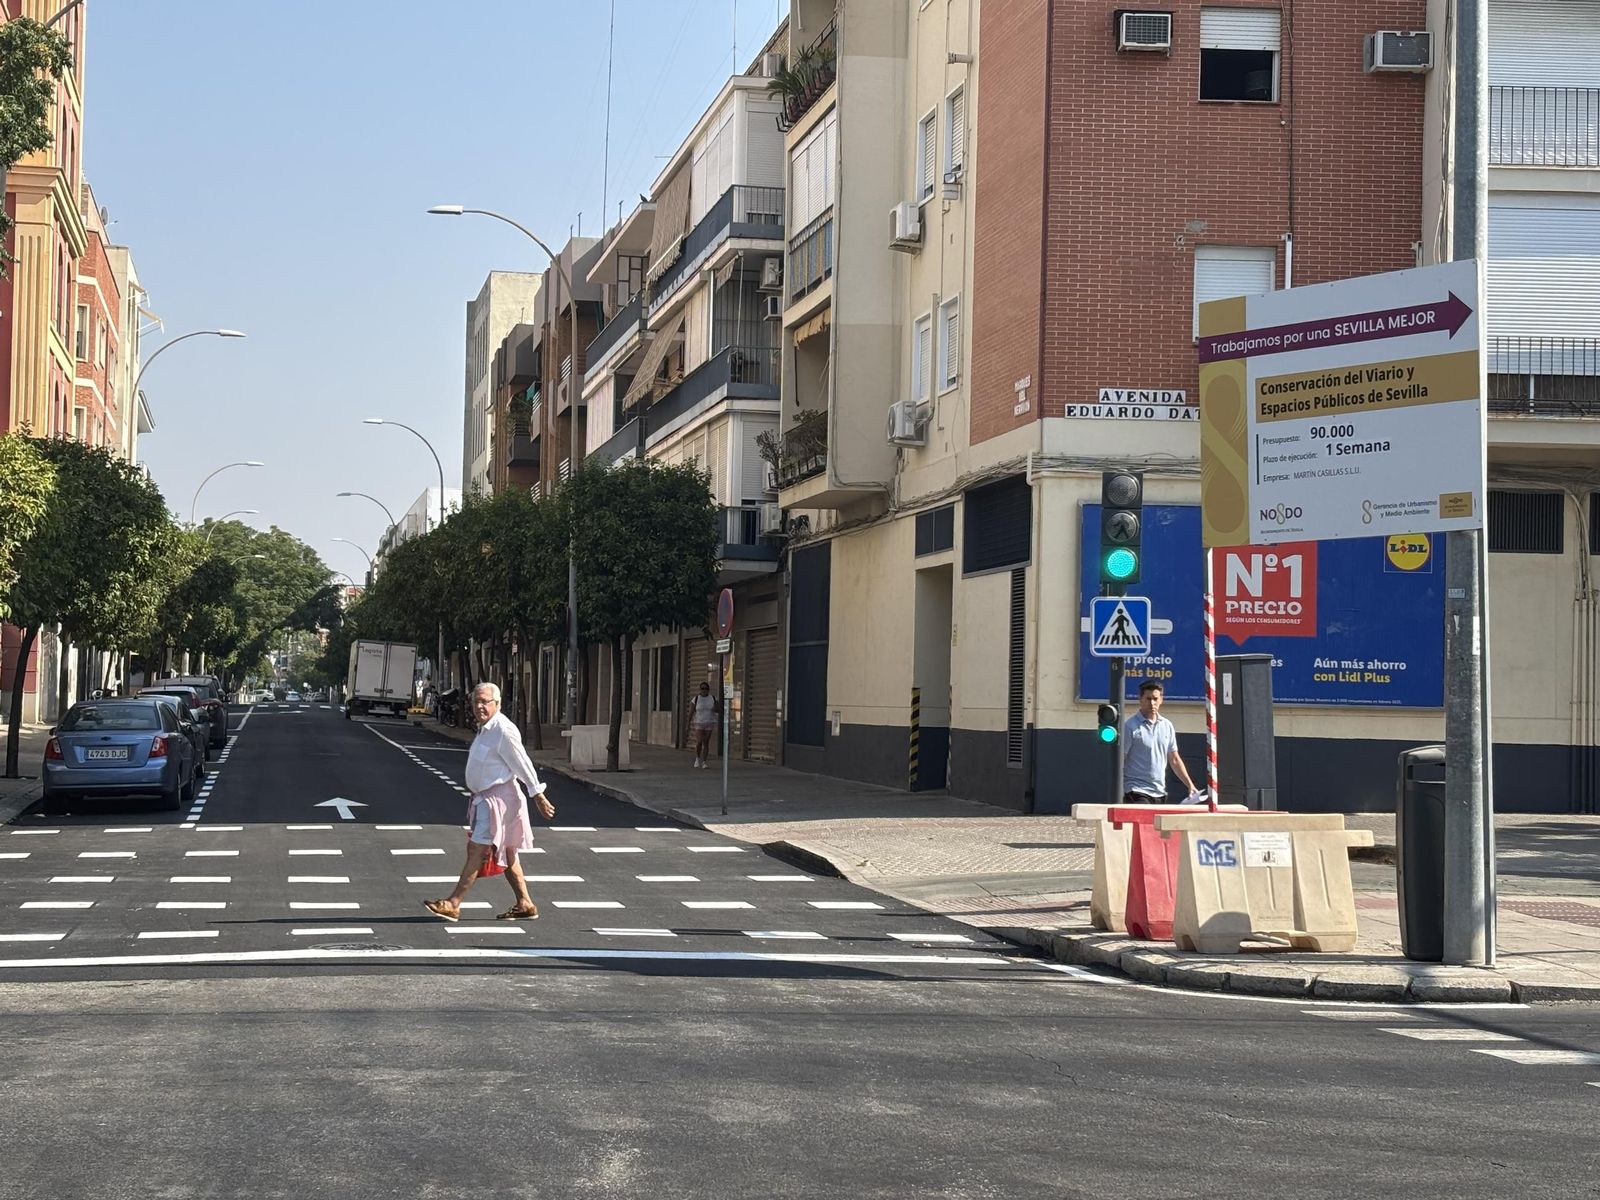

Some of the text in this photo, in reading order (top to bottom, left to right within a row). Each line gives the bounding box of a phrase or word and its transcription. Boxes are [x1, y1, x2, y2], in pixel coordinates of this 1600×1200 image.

[1210, 310, 1436, 354] Trabajamos por una SEVILLA MEJOR
[1260, 365, 1414, 395] Conservación del Viario y
[1101, 390, 1184, 403] AVENIDA
[1261, 384, 1428, 417] Espacios Públicos de Sevilla
[1066, 405, 1154, 418] EDUARDO
[1262, 424, 1354, 445] Presupuesto: 90.000
[1263, 455, 1278, 463] Plazo
[1326, 443, 1332, 455] 1
[1336, 441, 1390, 456] Semana
[1263, 474, 1290, 483] Empresa:
[1317, 467, 1344, 477] CASILLAS
[1225, 600, 1302, 615] PRECIO
[1134, 654, 1172, 666] precio
[1313, 657, 1407, 670] Aún más ahorro
[1146, 667, 1172, 680] bajo
[1313, 671, 1391, 683] con Lidl Plus
[90, 750, 110, 758] 4743
